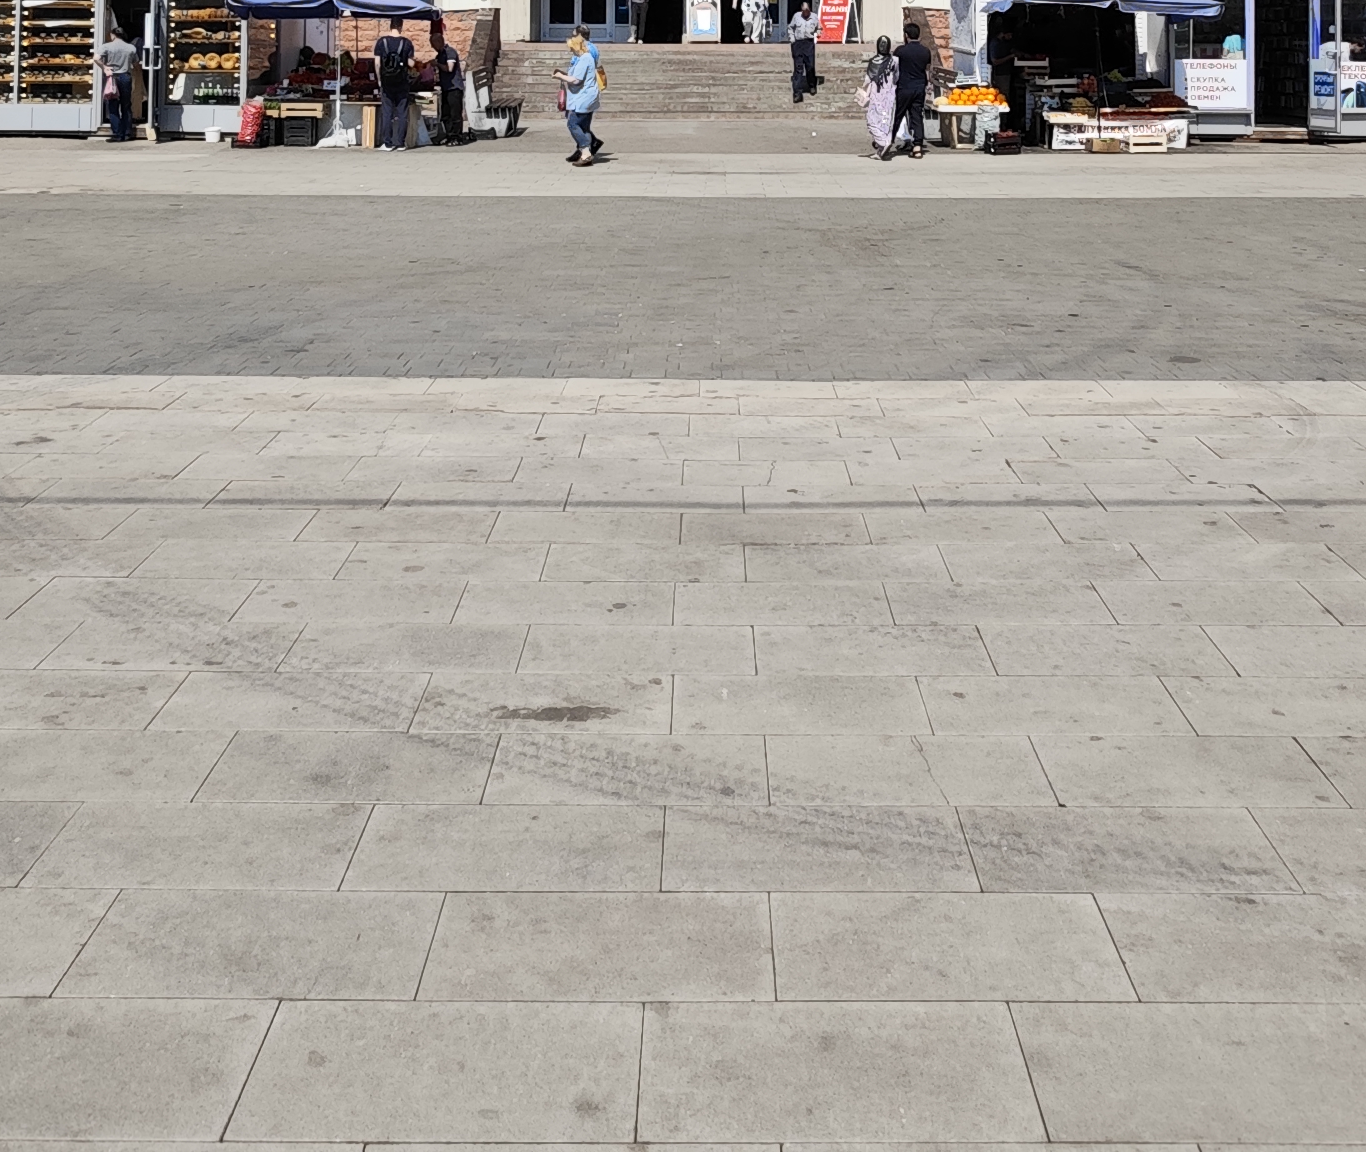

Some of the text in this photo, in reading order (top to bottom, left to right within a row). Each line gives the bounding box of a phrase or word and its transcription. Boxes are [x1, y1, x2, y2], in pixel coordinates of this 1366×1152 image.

[1184, 62, 1238, 70] ТЕЛЕФОНЫ
[1190, 76, 1227, 84] СКУПКА
[1190, 85, 1237, 93] ПРОДАЖА
